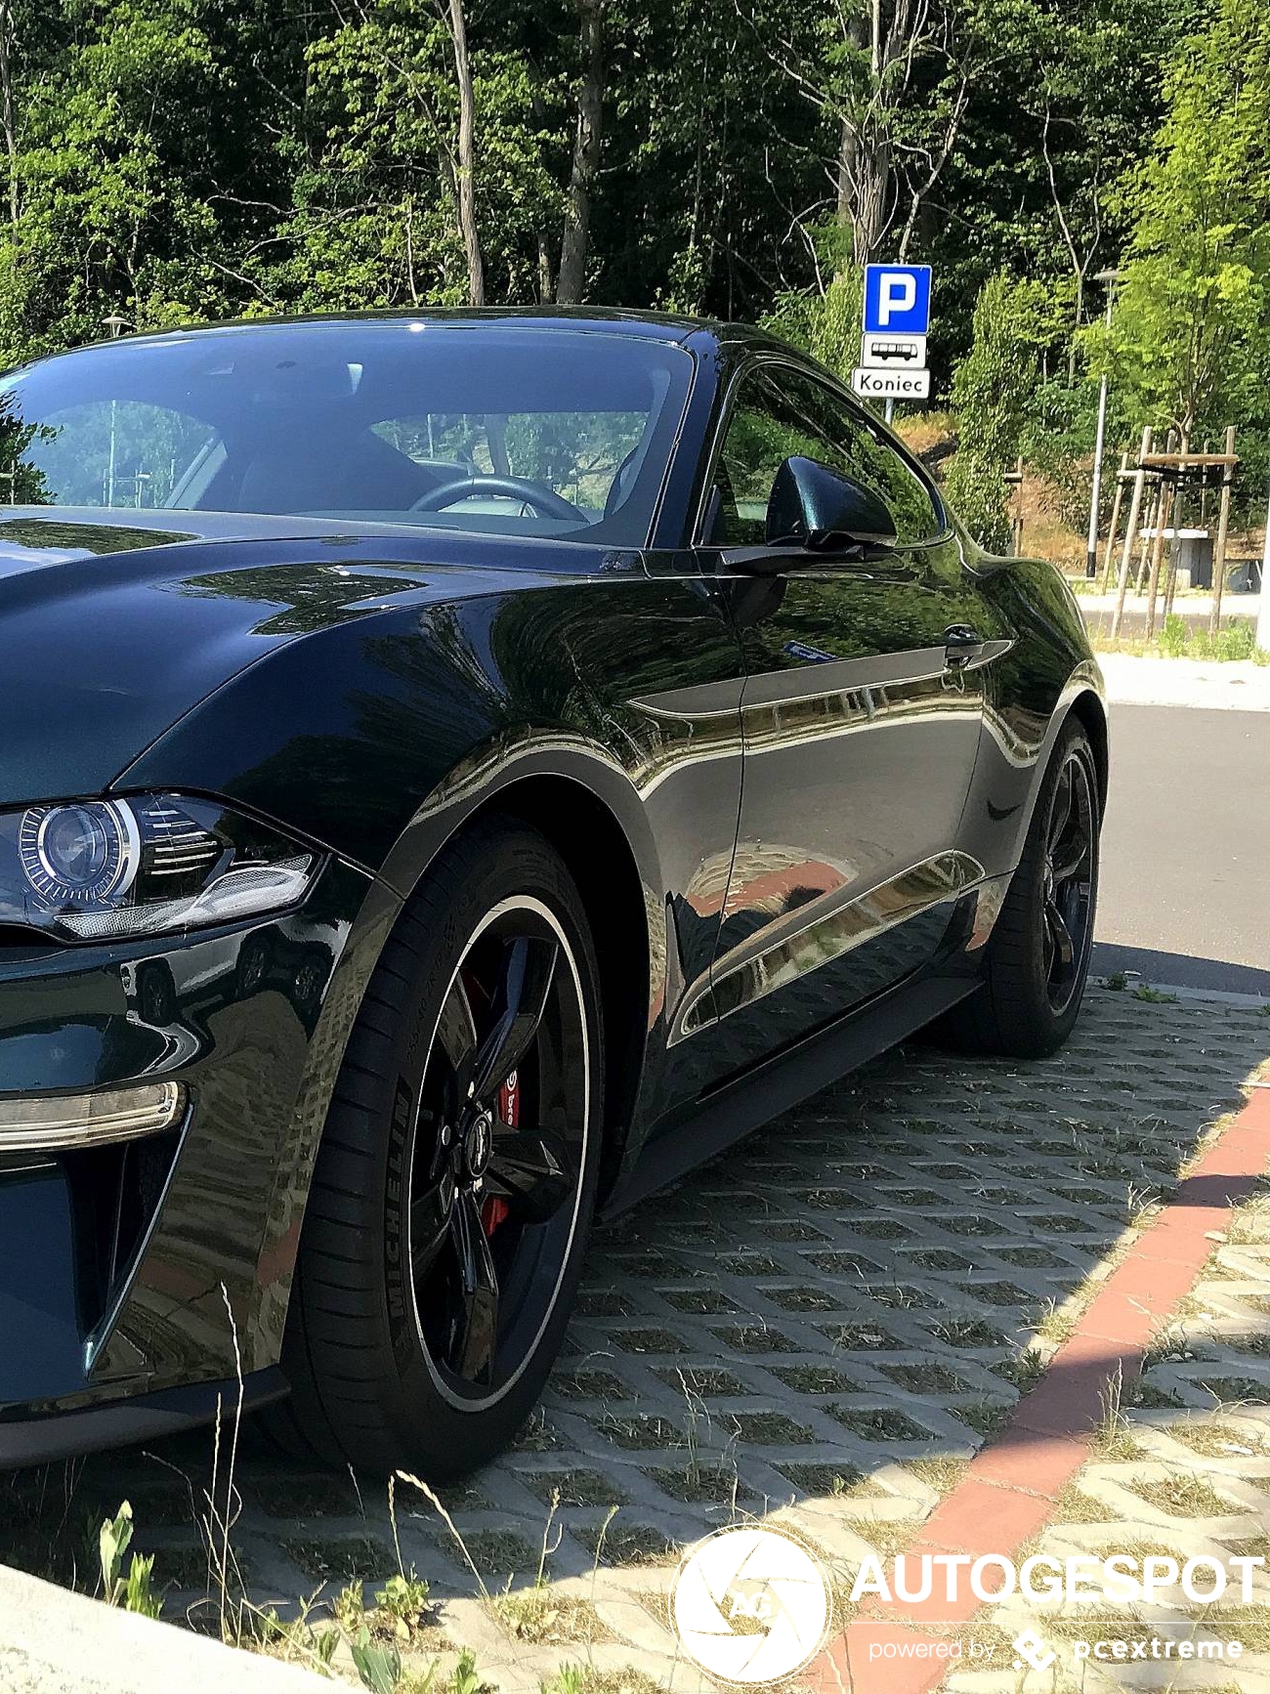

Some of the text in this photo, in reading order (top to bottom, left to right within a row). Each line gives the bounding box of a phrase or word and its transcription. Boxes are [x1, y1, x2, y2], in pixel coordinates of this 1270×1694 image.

[878, 272, 917, 326] P
[860, 373, 923, 393] Koniec
[385, 1091, 411, 1320] MICHELIN
